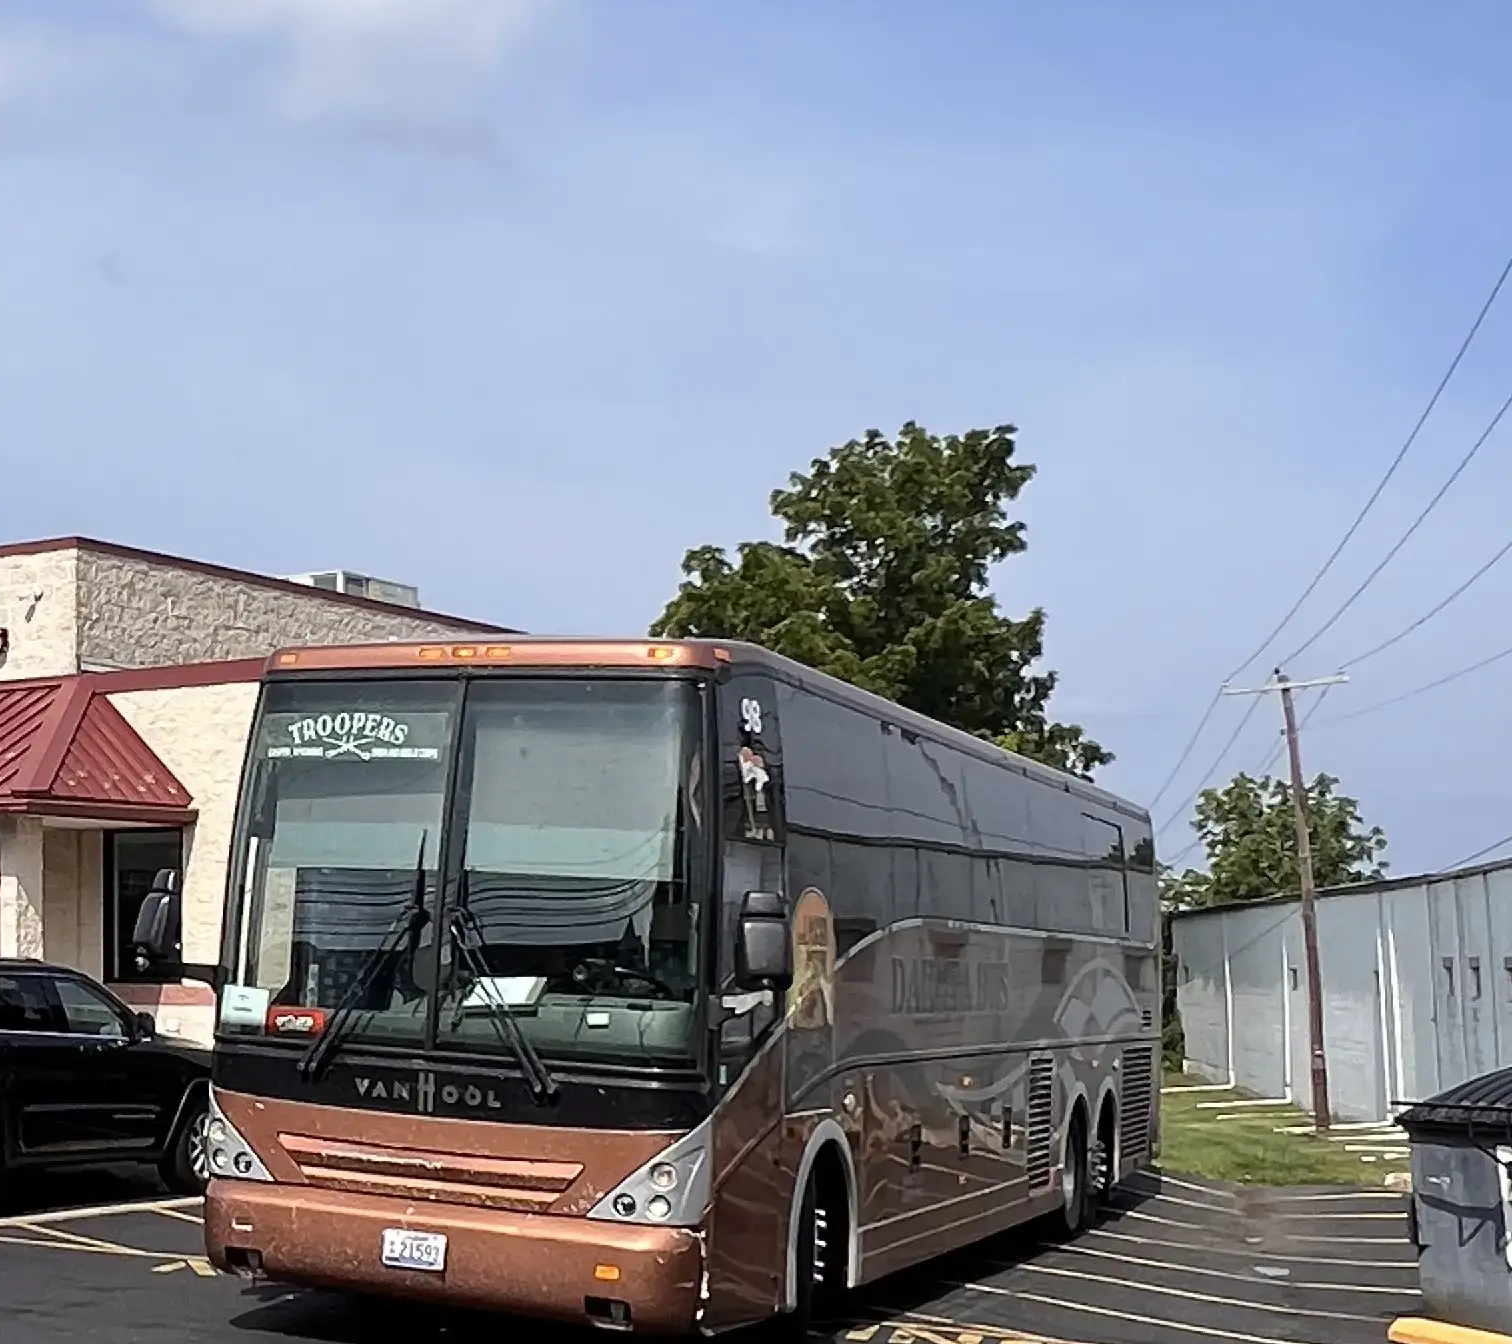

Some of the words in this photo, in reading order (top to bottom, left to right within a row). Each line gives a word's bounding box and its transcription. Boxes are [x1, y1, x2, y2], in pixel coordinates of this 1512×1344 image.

[288, 712, 409, 744] TROOPERS
[741, 698, 763, 734] 98
[354, 1076, 410, 1101] VAN
[417, 1071, 502, 1113] HOOL
